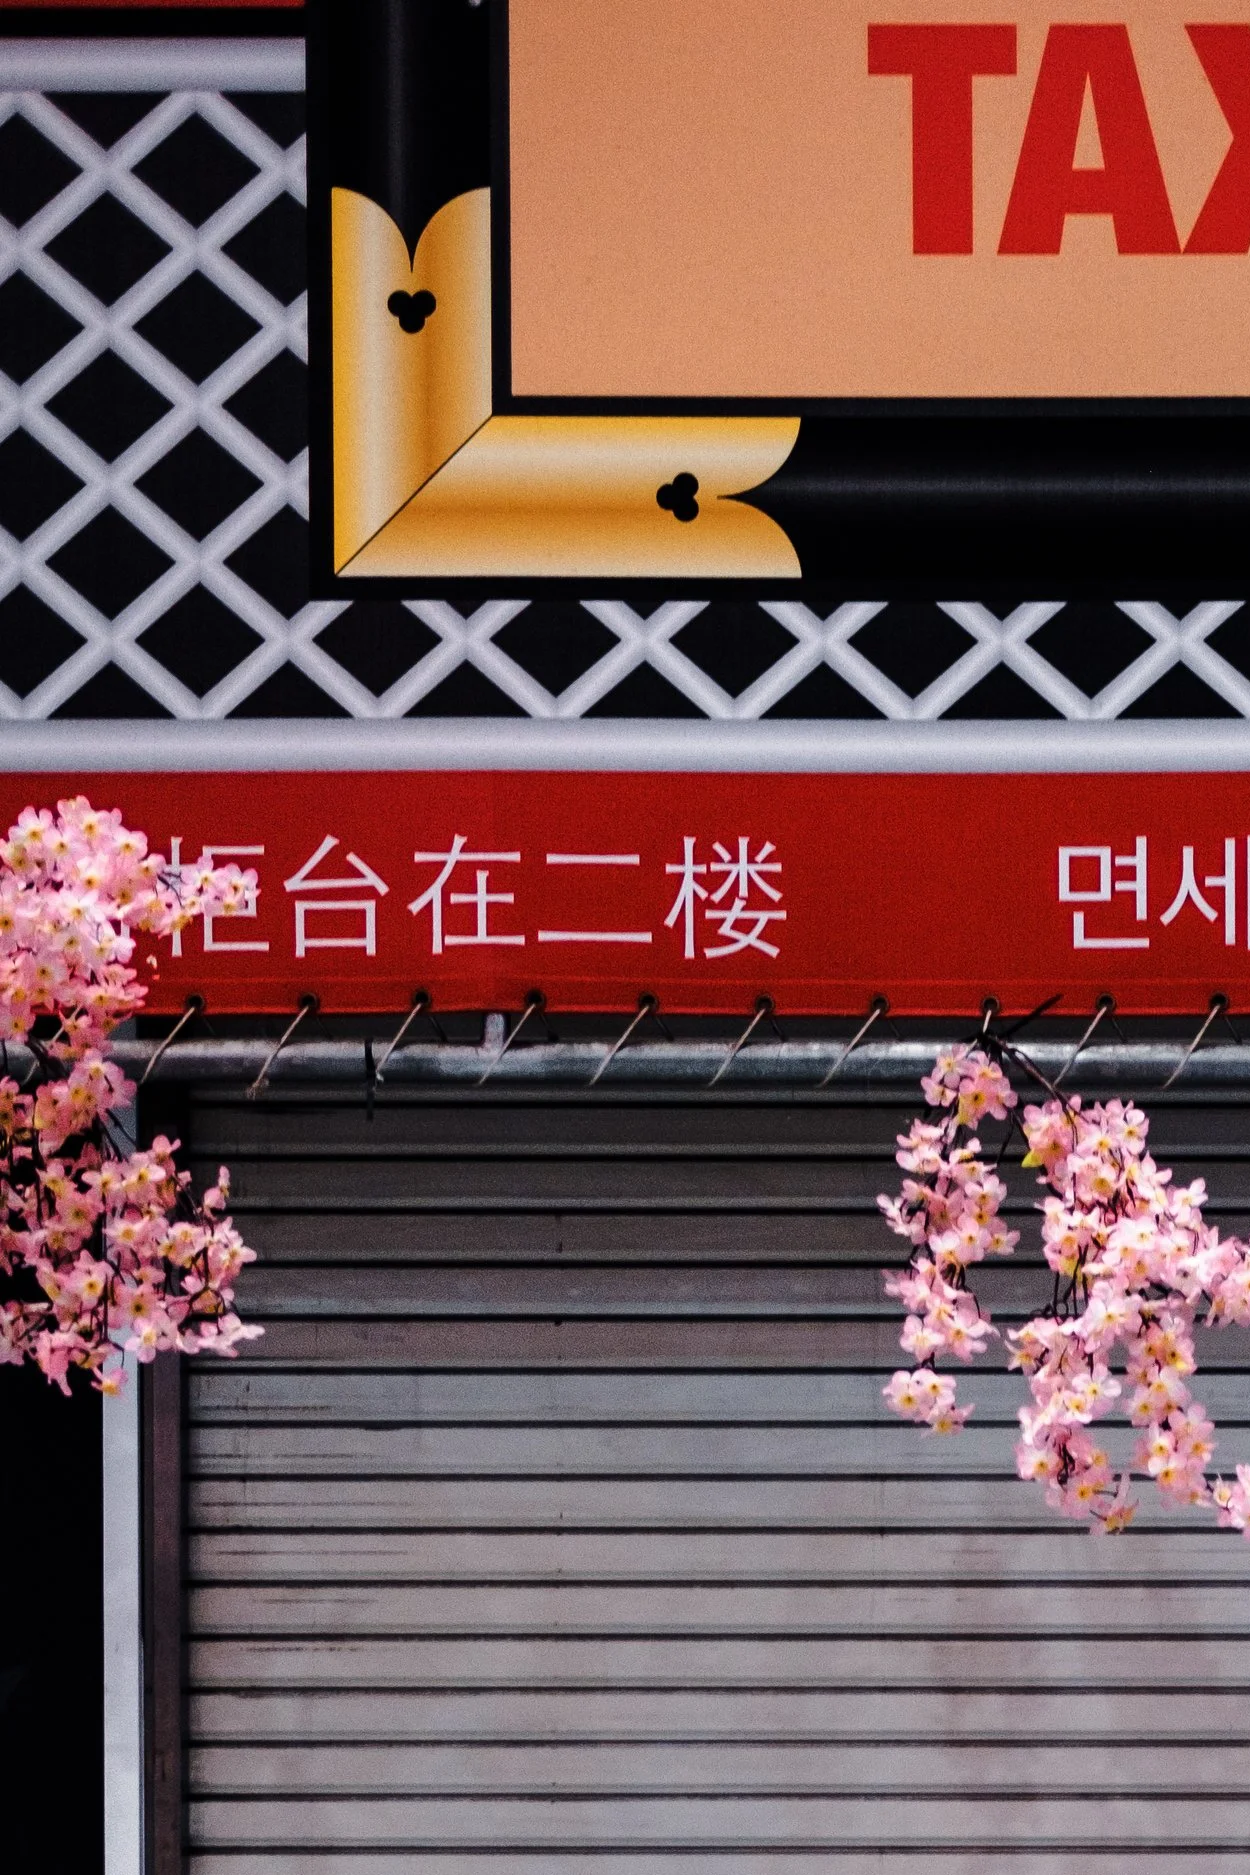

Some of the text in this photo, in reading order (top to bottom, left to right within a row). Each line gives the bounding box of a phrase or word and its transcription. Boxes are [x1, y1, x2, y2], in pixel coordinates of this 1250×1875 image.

[121, 833, 787, 959] 柜台在二楼
